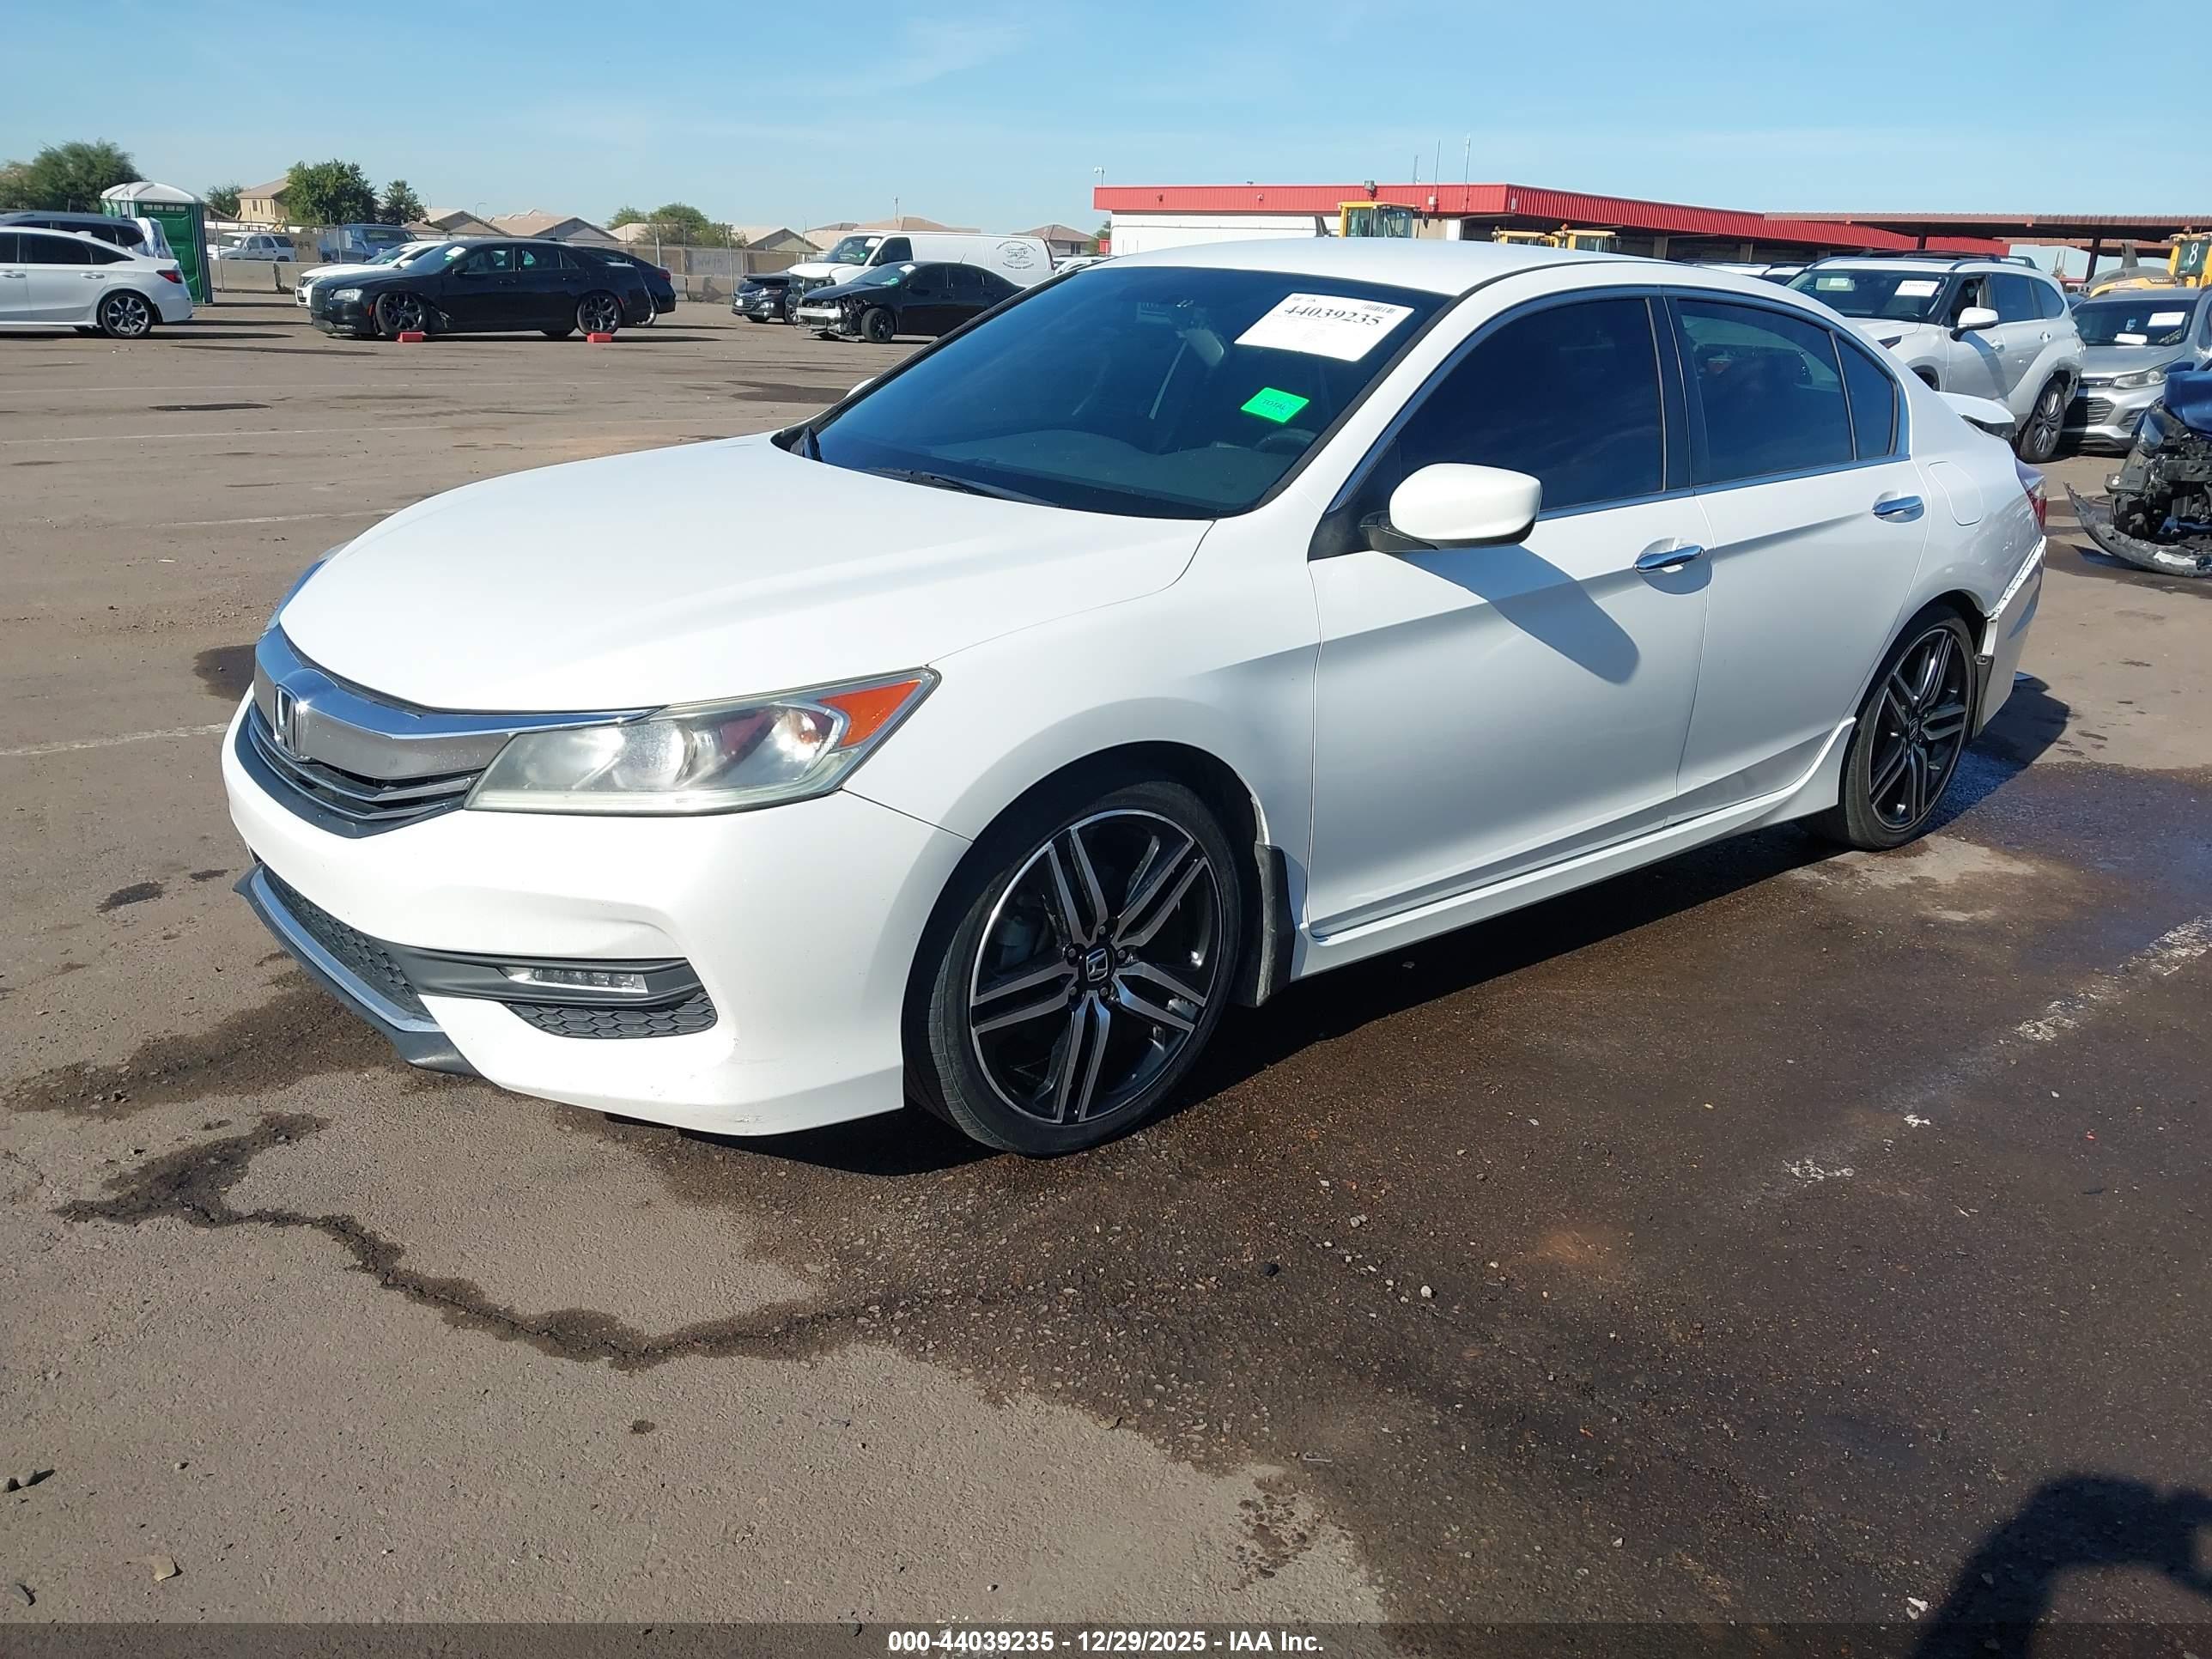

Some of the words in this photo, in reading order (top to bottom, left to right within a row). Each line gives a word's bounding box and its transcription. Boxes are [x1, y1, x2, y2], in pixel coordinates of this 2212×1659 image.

[2188, 242, 2199, 265] 8
[1284, 305, 1386, 326] 44039235
[1261, 398, 1286, 410] TOTAL
